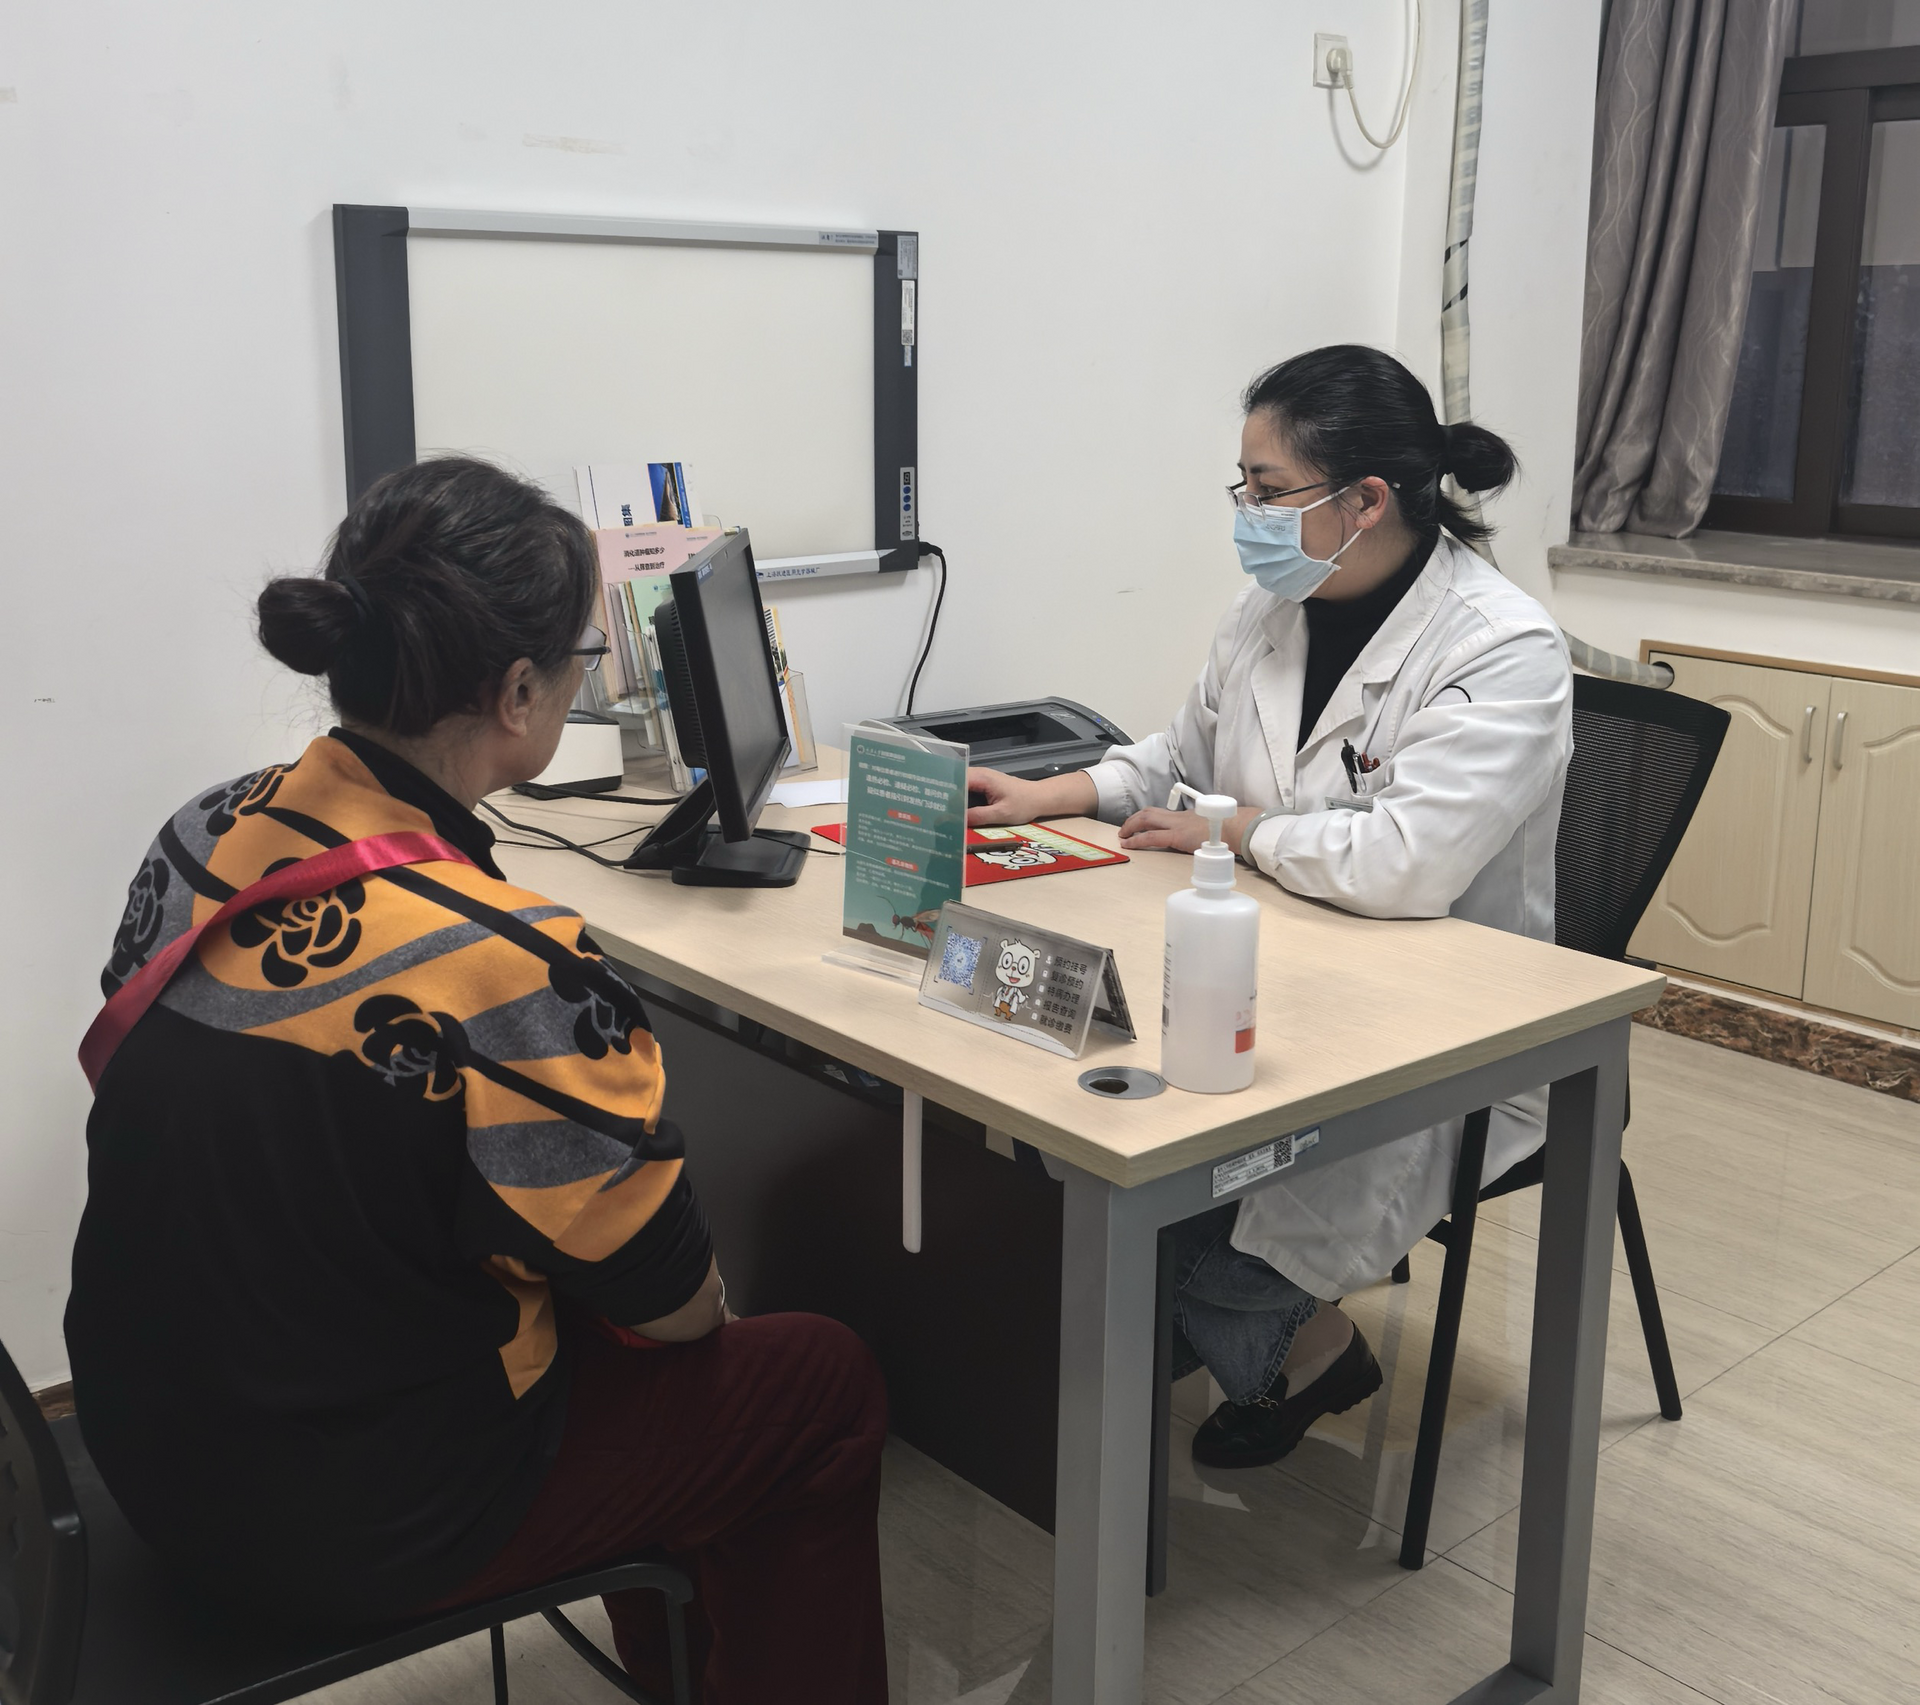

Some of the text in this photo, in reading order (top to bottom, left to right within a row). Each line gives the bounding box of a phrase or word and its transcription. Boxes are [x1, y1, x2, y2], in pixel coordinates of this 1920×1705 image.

[624, 547, 665, 557] 消化道肿瘤知多少
[1054, 956, 1087, 975] 预约挂号
[1051, 970, 1084, 990] 复诊预约
[1047, 986, 1080, 1005] 特病办理
[1042, 999, 1077, 1020] 报告查询
[1039, 1014, 1073, 1035] 就诊缴费
